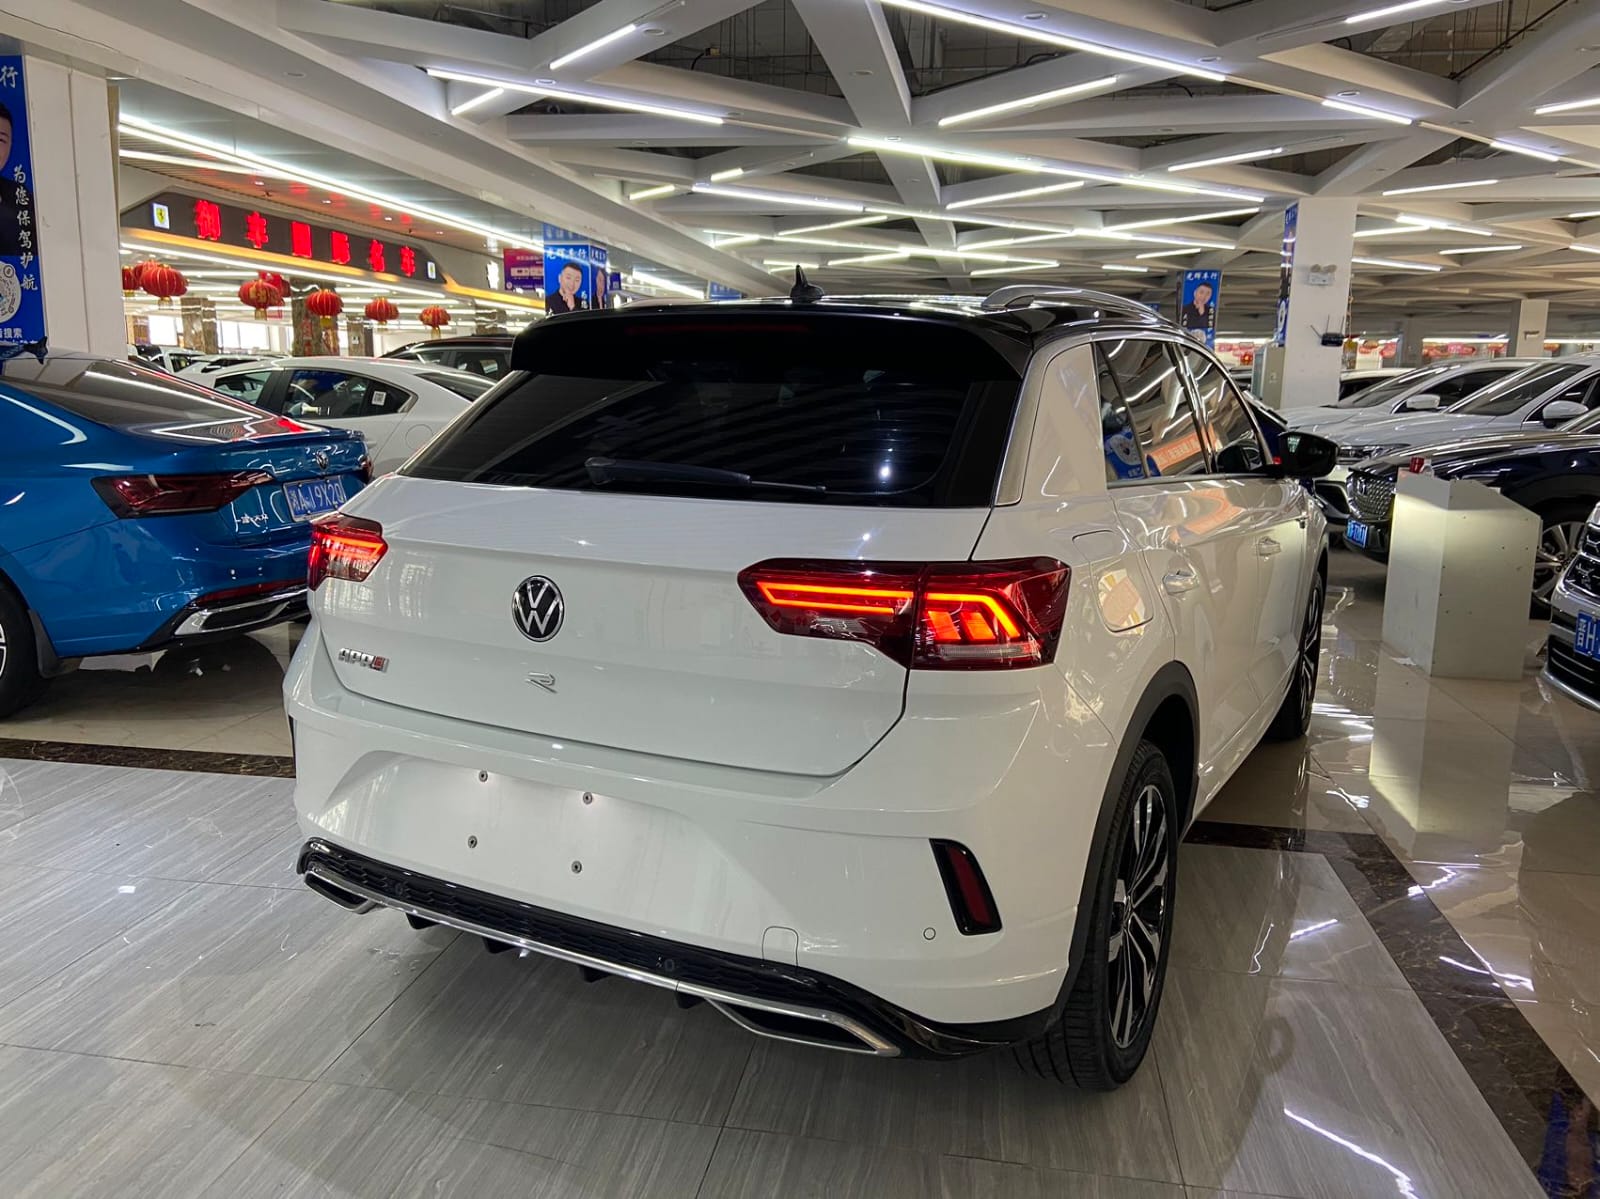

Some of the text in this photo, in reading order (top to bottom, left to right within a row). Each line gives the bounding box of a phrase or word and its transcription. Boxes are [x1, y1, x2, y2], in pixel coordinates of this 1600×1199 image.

[0, 65, 18, 88] 行
[14, 164, 38, 291] 为您保驾护航
